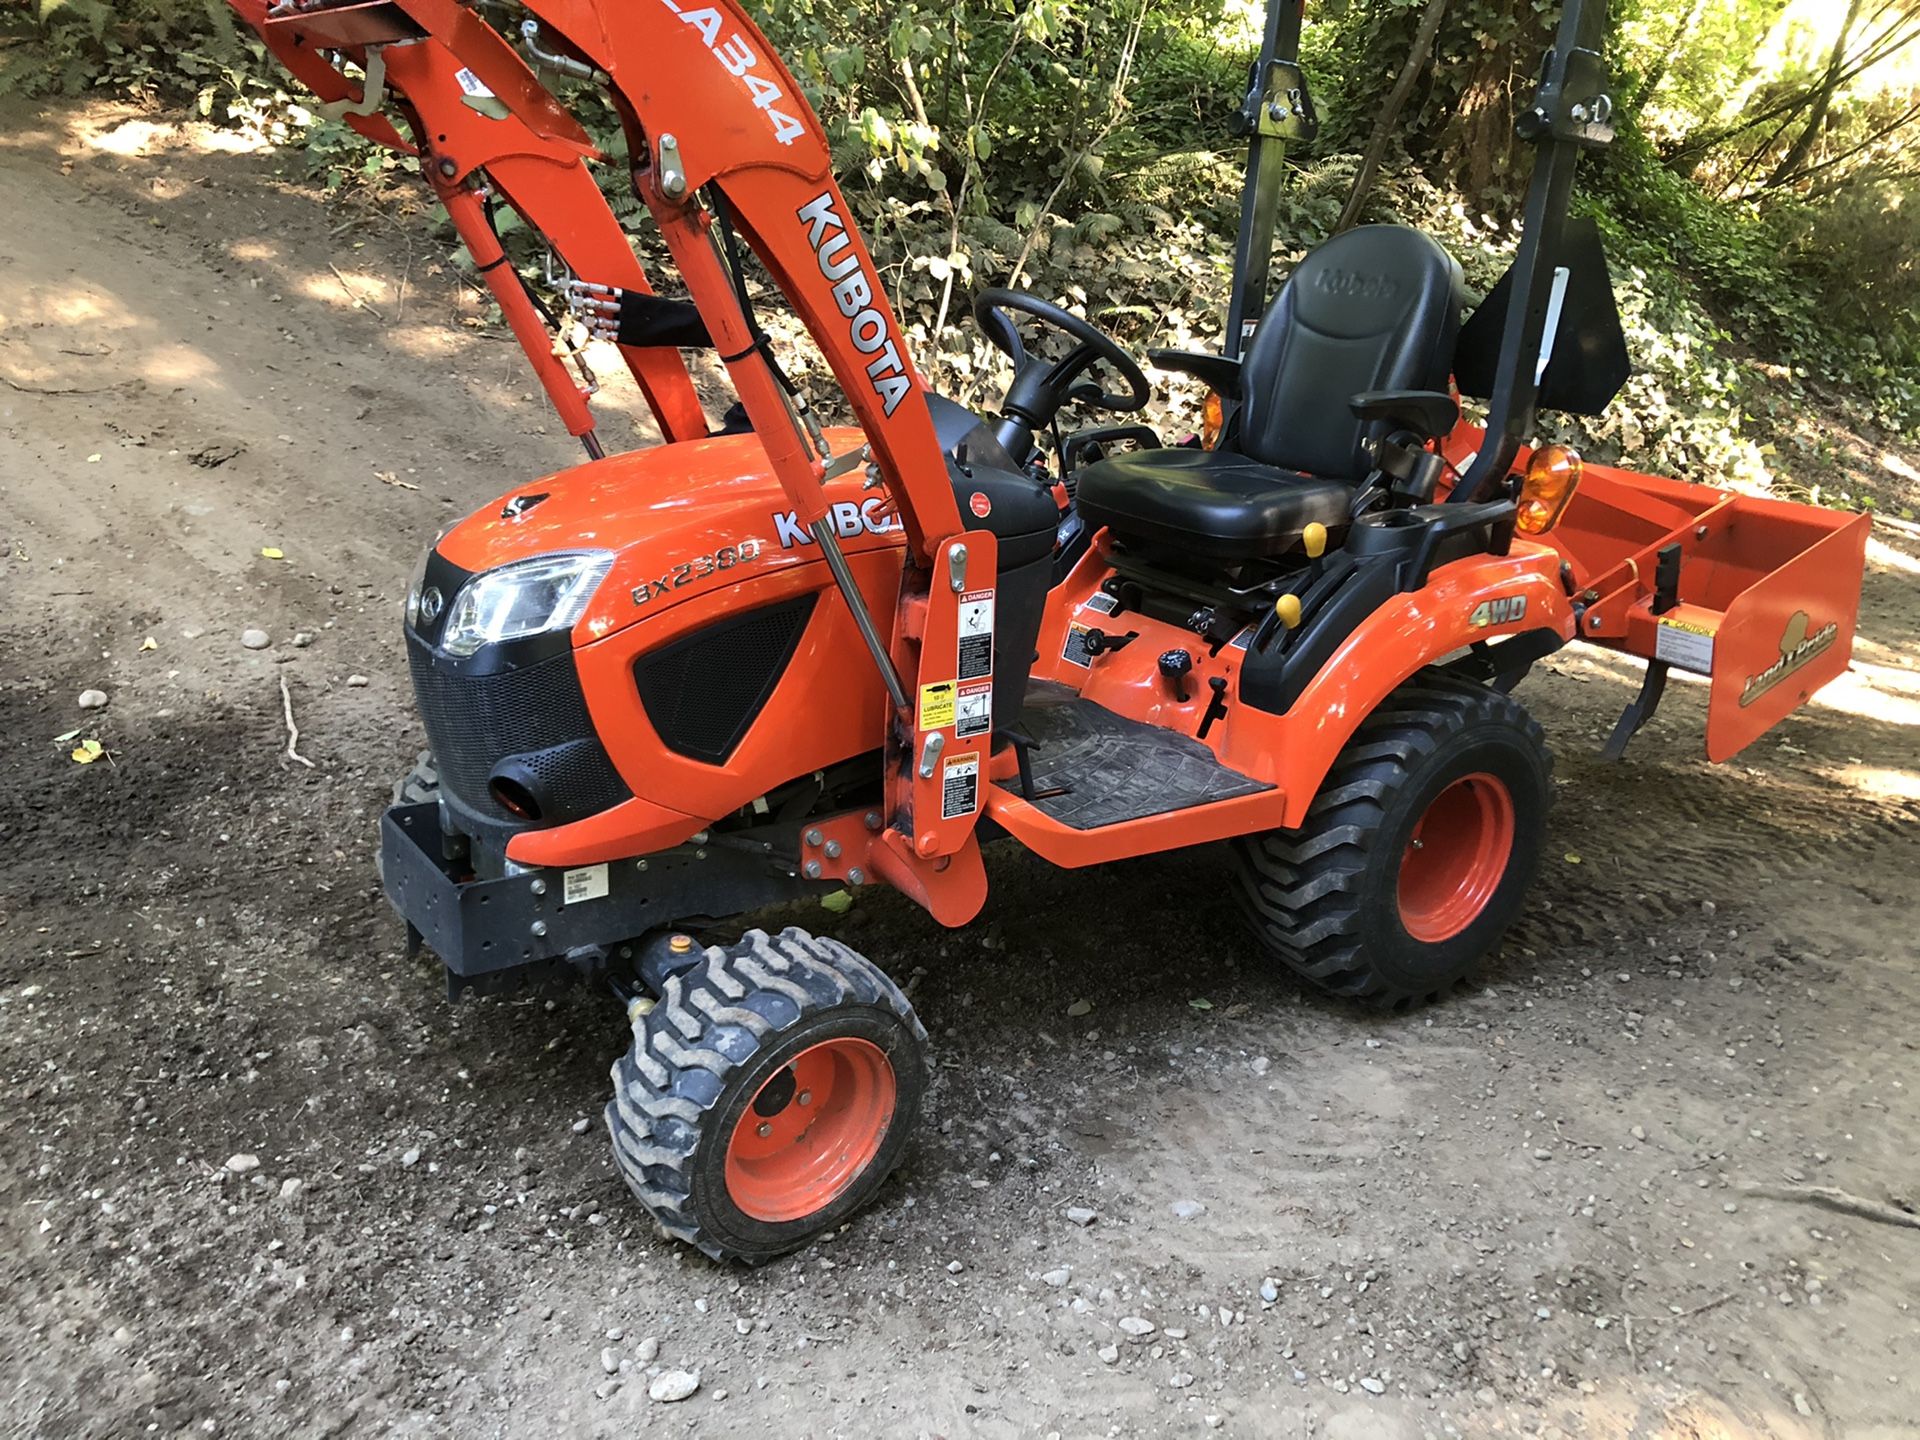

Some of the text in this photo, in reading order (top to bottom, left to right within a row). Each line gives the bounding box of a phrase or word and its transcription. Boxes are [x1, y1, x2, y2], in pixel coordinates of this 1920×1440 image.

[796, 191, 912, 417] KUBOTA
[631, 538, 762, 606] BX2380
[967, 592, 992, 601] DANGER
[1469, 594, 1527, 627] 4WD
[1676, 621, 1710, 636] CAUTION
[966, 685, 990, 695] DANGER
[923, 702, 953, 713] LUBRICATE
